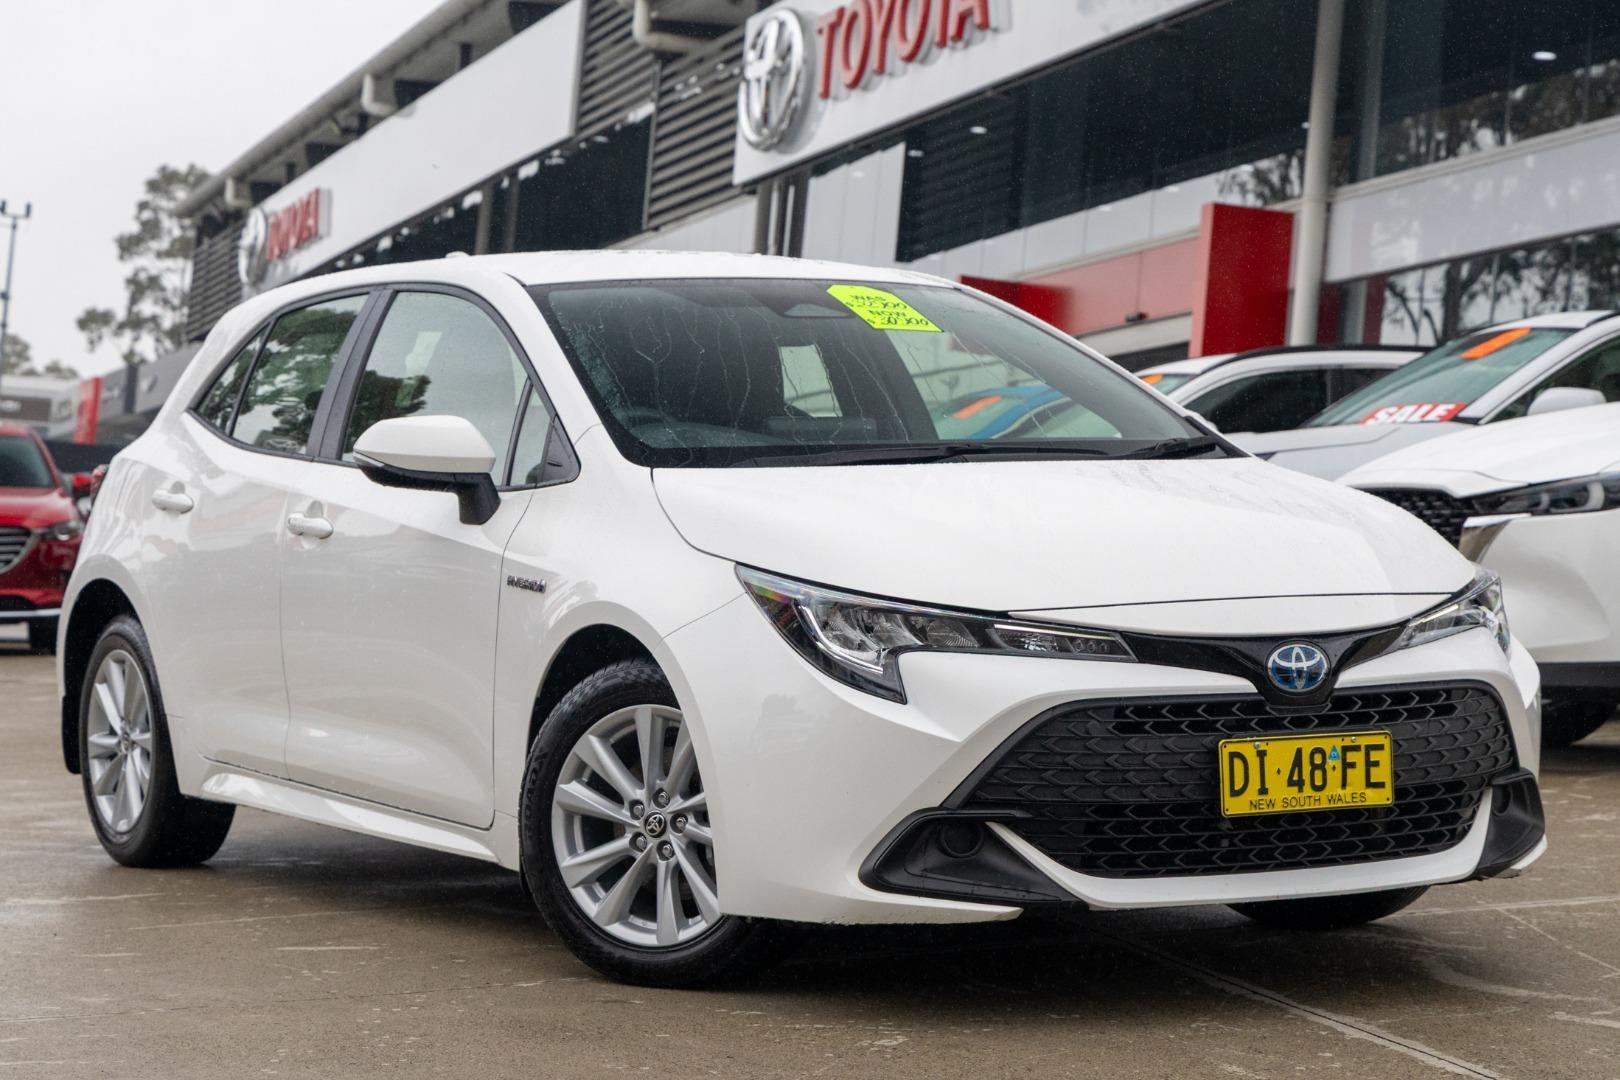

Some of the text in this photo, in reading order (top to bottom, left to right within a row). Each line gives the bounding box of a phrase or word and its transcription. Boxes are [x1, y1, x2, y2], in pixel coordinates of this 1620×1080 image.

[1364, 403, 1456, 424] SALE
[1287, 746, 1328, 793] 48
[1341, 744, 1386, 790] FE
[1249, 791, 1368, 811] NEW SOUTH WALES
